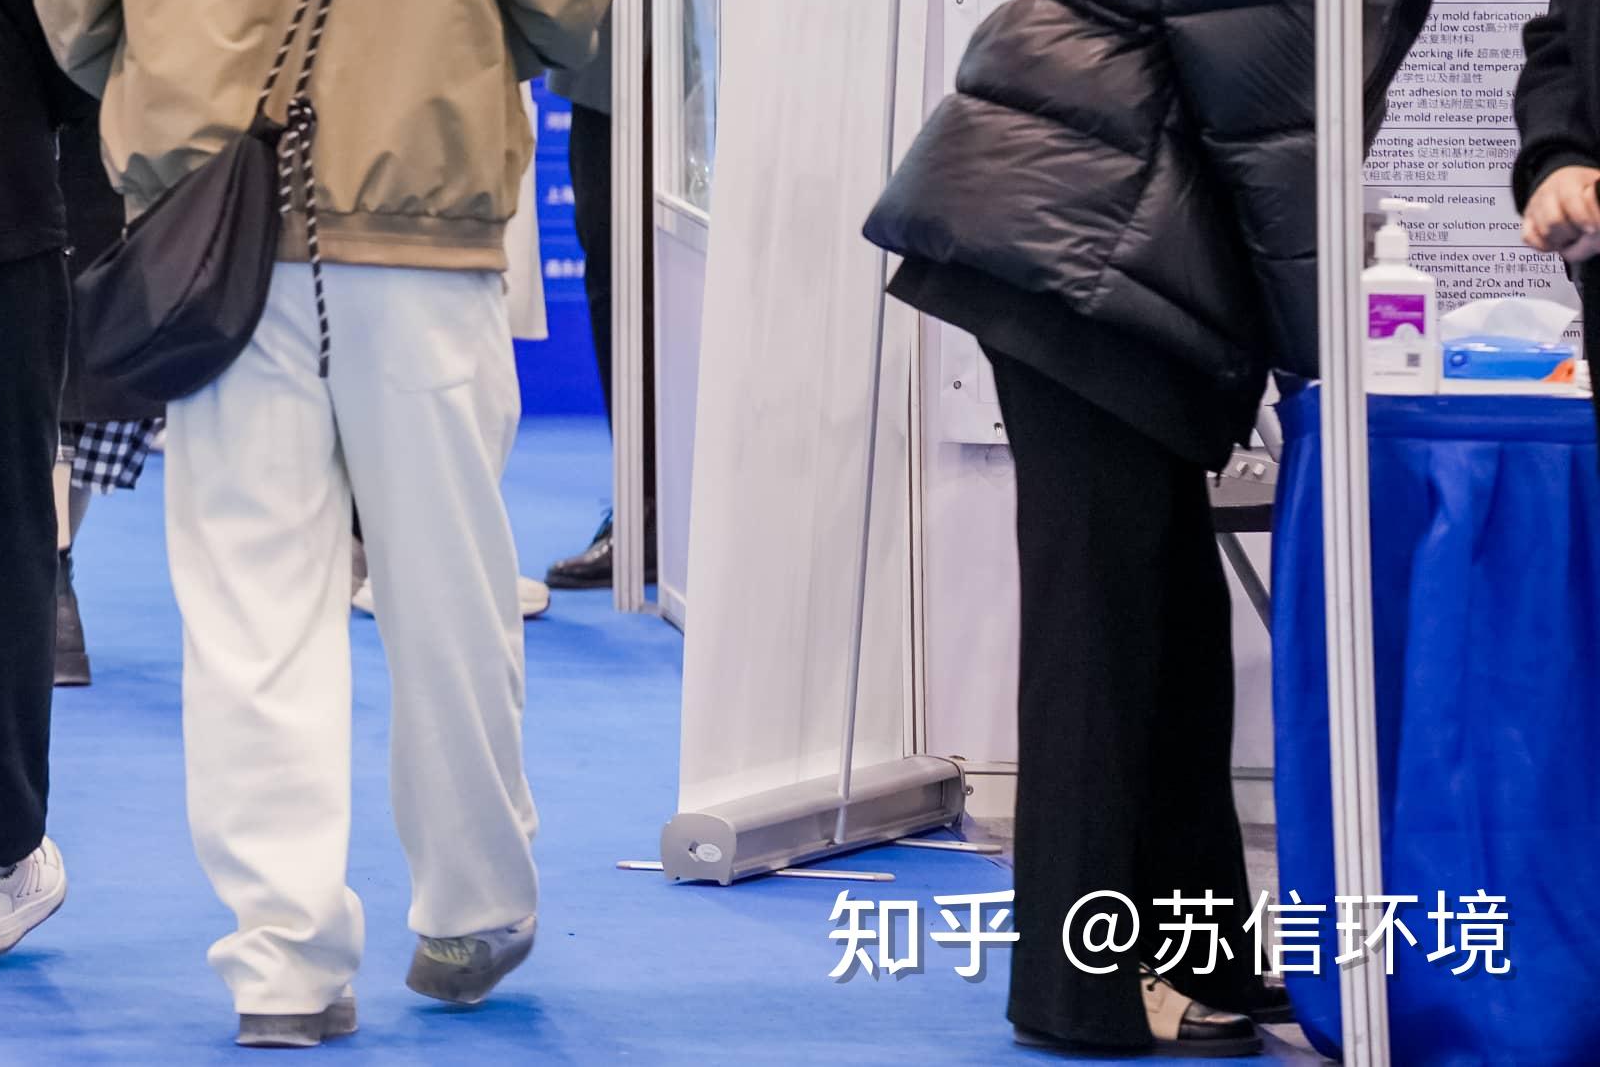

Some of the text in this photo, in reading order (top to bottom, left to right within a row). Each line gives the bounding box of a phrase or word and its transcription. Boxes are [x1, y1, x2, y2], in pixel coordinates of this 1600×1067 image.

[1443, 11, 1532, 22] mold fabrication
[1440, 22, 1459, 32] low
[1408, 48, 1473, 60] working life
[1450, 61, 1469, 72] and
[1409, 87, 1502, 99] adhesion to mold
[1404, 112, 1473, 122] mold release
[1417, 137, 1518, 148] adhesion between
[1393, 159, 1485, 172] phase or solution
[1417, 194, 1444, 204] mold
[1448, 195, 1495, 206] releasing
[1428, 220, 1485, 231] or solution
[1440, 251, 1556, 264] index over 1.9 optical
[1416, 264, 1490, 273] transmittance
[1453, 278, 1551, 288] and ZrOx and TiOx
